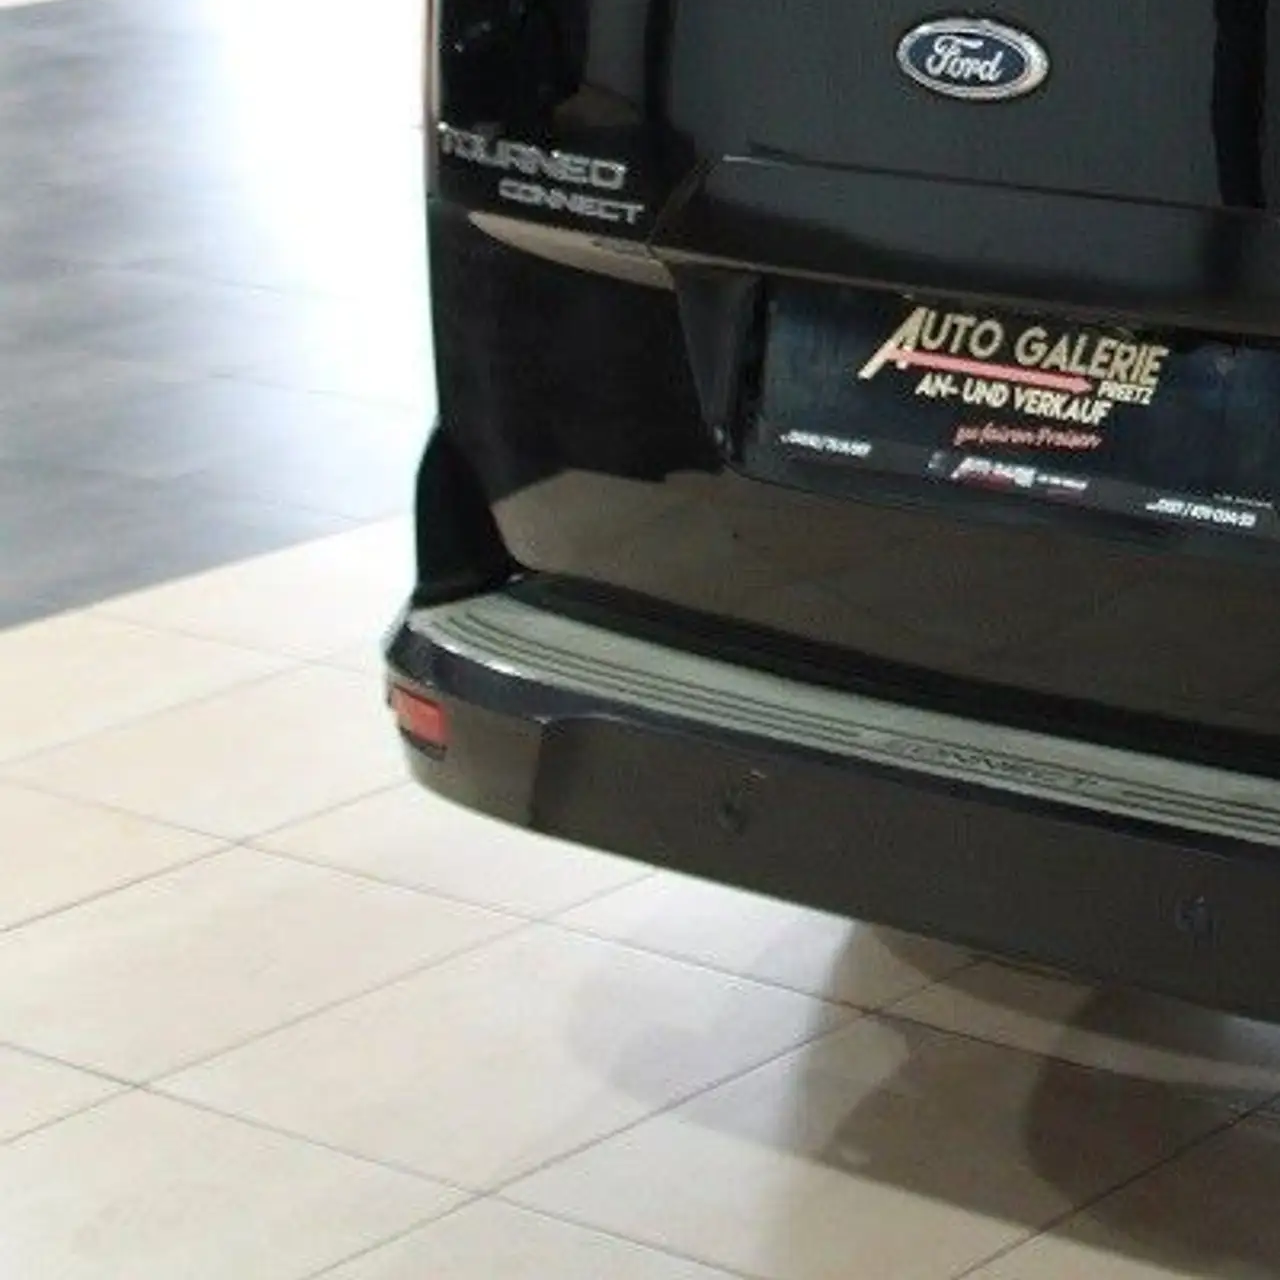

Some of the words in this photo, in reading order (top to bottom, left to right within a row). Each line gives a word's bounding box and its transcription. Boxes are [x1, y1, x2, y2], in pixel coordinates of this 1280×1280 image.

[925, 34, 1004, 83] Ford
[437, 121, 627, 191] TOURNEO
[499, 177, 645, 225] CONNECT
[858, 306, 1004, 380] AUTO
[1014, 325, 1169, 385] GALERIE
[915, 373, 958, 398] AN-
[962, 382, 1008, 409] UND
[1014, 388, 1114, 426] VERKAUF
[1097, 380, 1154, 405] PREETZ
